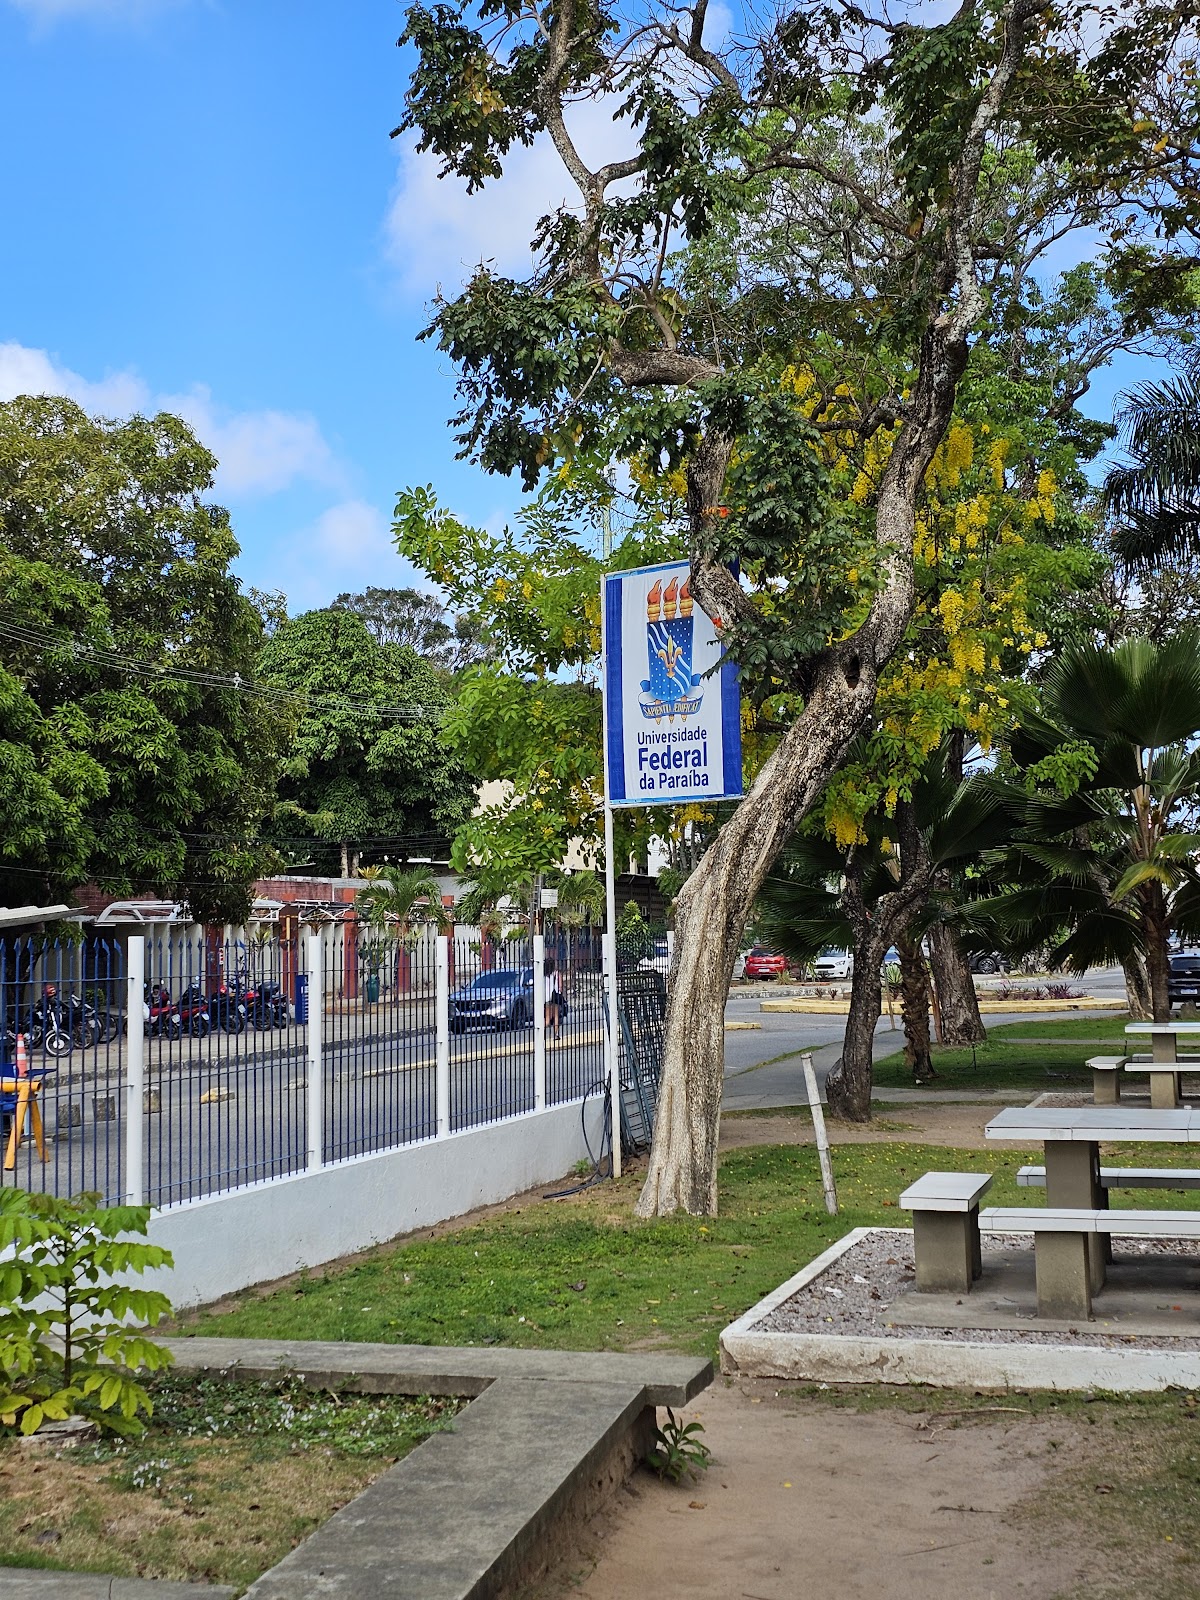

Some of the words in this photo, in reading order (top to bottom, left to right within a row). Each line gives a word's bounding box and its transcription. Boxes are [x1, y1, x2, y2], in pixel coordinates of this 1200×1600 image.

[637, 725, 707, 745] Universidade
[638, 741, 708, 771] Federal
[639, 772, 655, 790] da
[659, 769, 709, 789] Paraíba
